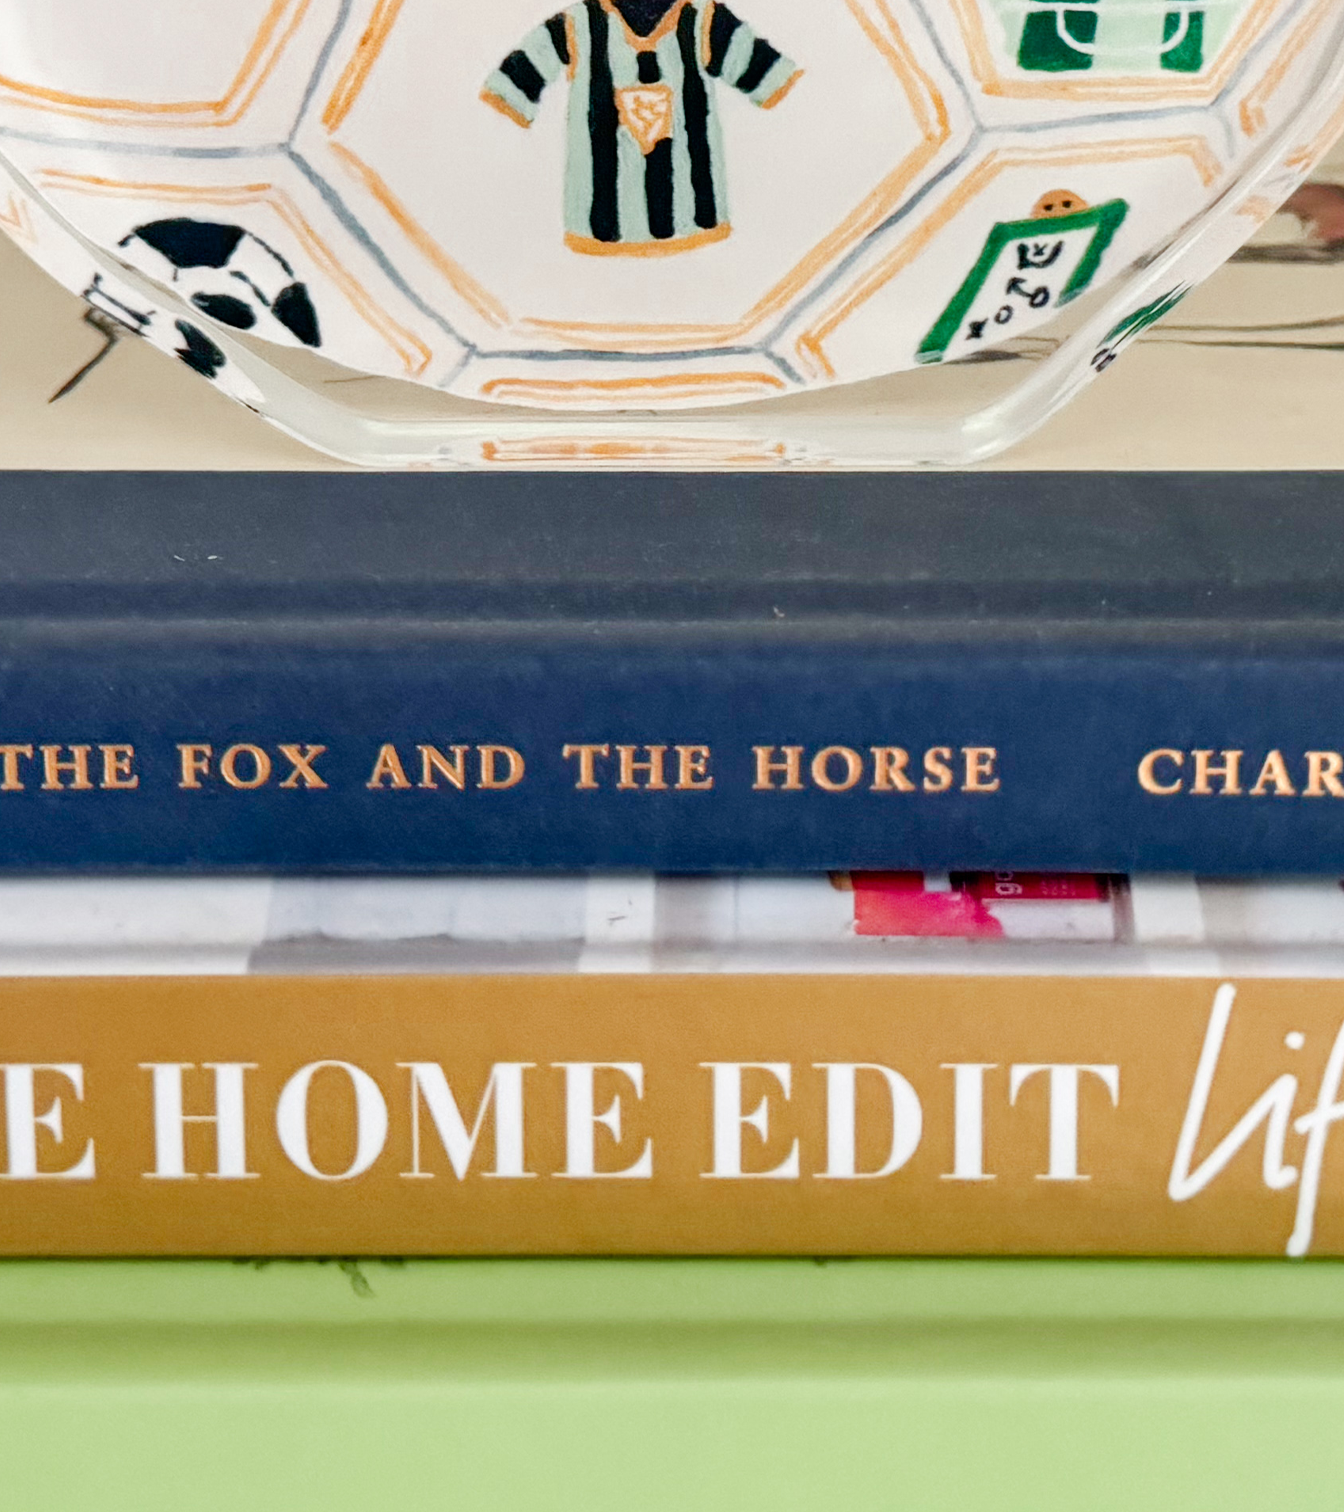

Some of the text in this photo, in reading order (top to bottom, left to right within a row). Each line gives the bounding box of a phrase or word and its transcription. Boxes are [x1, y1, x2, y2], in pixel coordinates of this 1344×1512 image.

[177, 744, 329, 790] FOX
[367, 744, 526, 791] AND
[563, 744, 714, 791] THE
[753, 746, 1001, 794] HORSE
[140, 1060, 654, 1182] HOME
[700, 1062, 1121, 1182] EDIT
